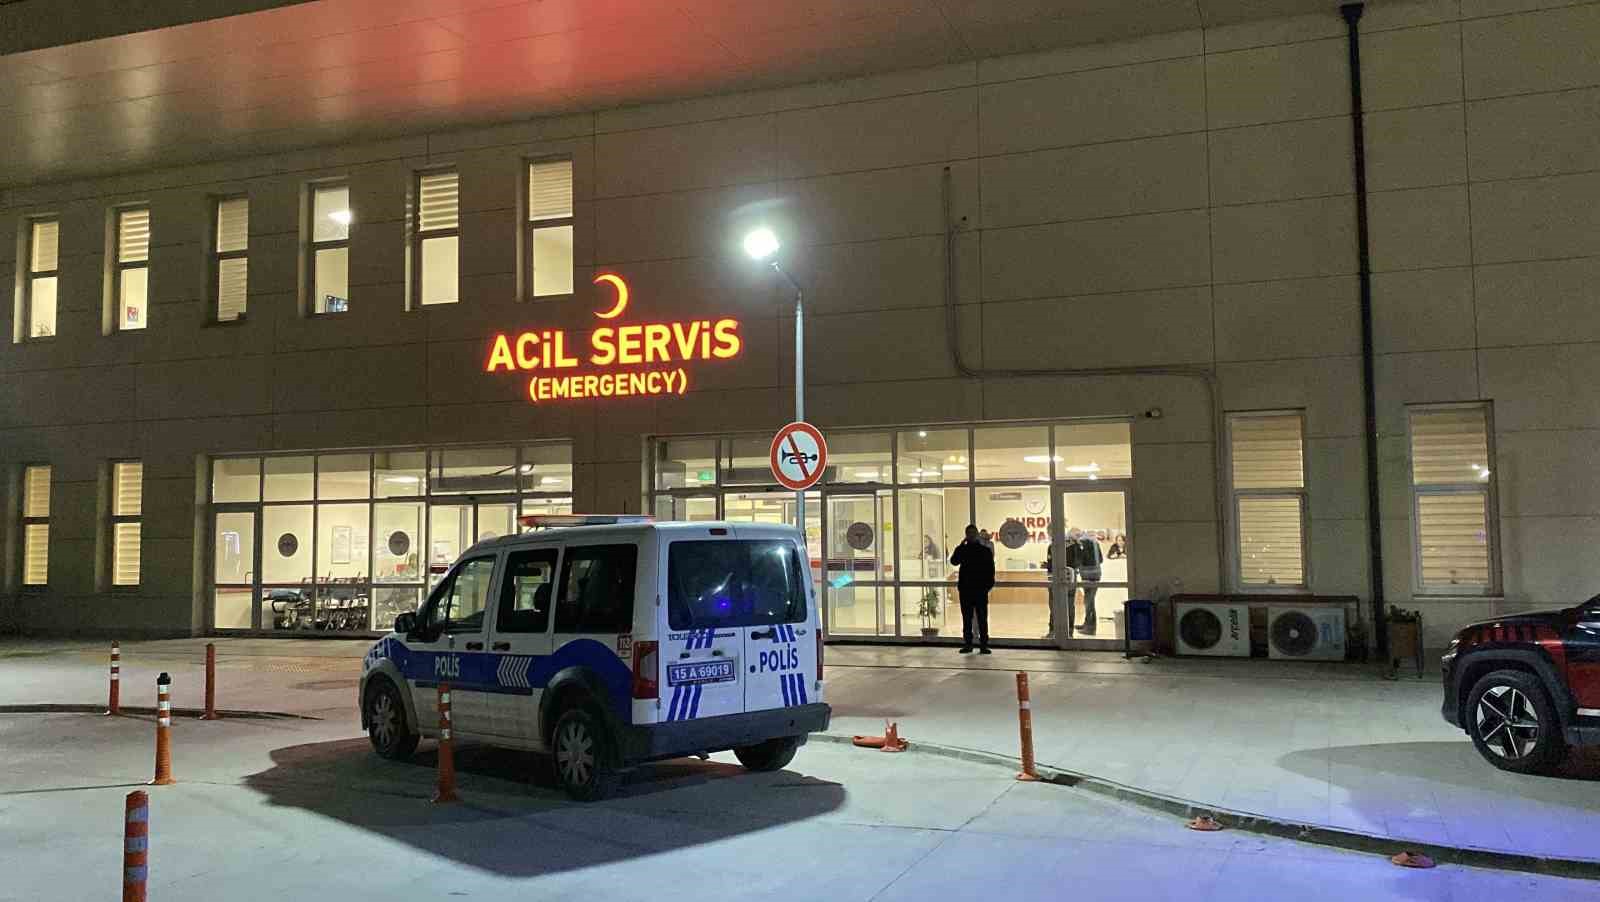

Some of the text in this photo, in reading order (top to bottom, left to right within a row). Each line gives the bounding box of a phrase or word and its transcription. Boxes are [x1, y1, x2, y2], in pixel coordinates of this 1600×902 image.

[529, 368, 688, 402] (EMERGENCY)
[434, 653, 460, 677] POLİS
[759, 643, 799, 673] POLİS
[674, 664, 730, 680] 15 A 69019
